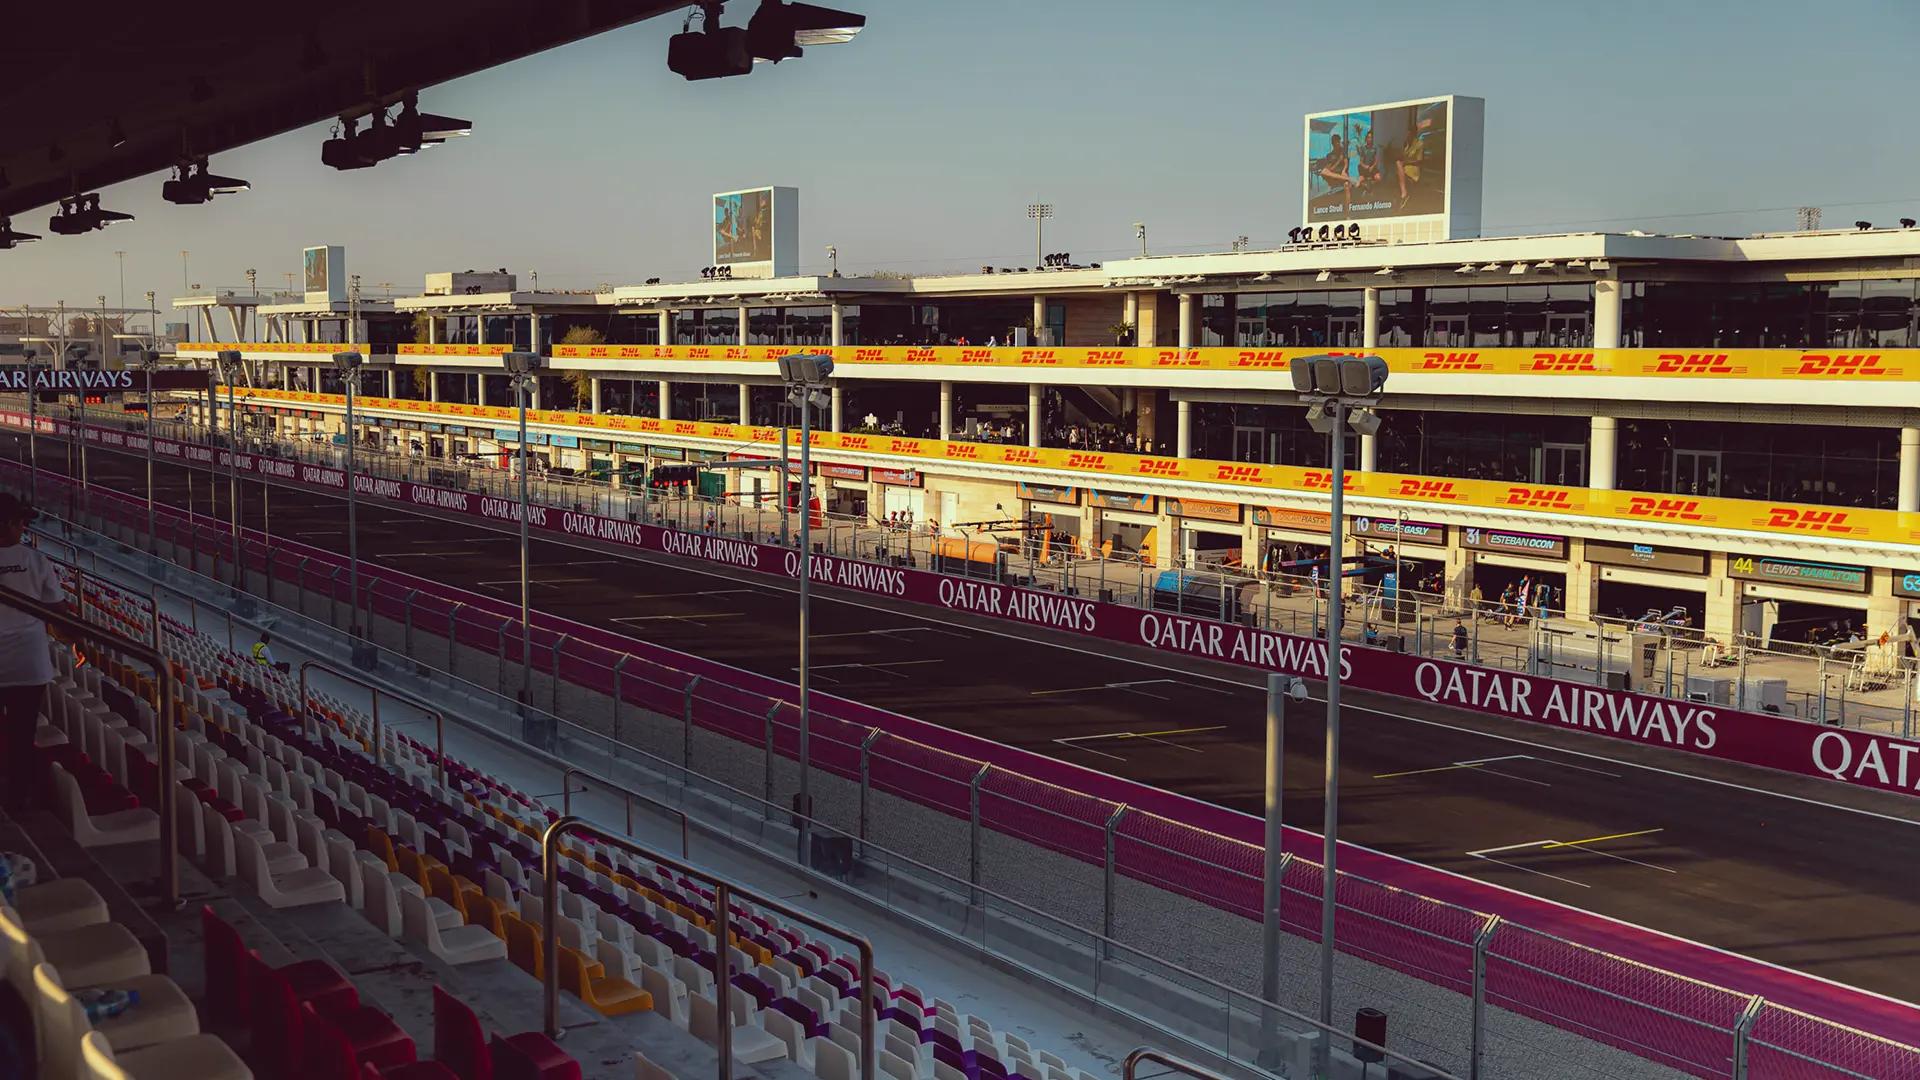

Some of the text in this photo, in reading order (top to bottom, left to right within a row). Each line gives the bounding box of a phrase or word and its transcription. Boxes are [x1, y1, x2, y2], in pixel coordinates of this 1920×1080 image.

[1313, 206, 1328, 214] Lance
[1348, 202, 1373, 211] Fernando
[1373, 201, 1392, 209] Alonso
[621, 348, 640, 357] DHL
[654, 348, 674, 357] DHL
[689, 349, 709, 358] DHL
[726, 349, 748, 359] DHL
[855, 349, 884, 361] DHL
[907, 350, 937, 362] DHL
[961, 350, 993, 363] DHL
[1021, 351, 1056, 364] DHL
[1087, 351, 1125, 364] DHL
[1158, 352, 1201, 365] DHL
[1237, 352, 1287, 367] DHL
[1422, 353, 1482, 370] DHL
[1531, 353, 1597, 371] DHL
[1656, 354, 1735, 373] DHL
[1798, 355, 1886, 375] DHL
[35, 370, 132, 388] AIRWAYS
[641, 421, 660, 430] DHL
[675, 423, 696, 434] DHL
[713, 426, 734, 437] DHL
[752, 429, 776, 441] DHL
[841, 436, 868, 449] DHL
[891, 440, 920, 453] DHL
[946, 444, 977, 458] DHL
[1004, 449, 1040, 463] DHL
[1068, 454, 1106, 469] DHL
[1139, 459, 1180, 476] DHL
[1217, 465, 1263, 483] DHL
[412, 485, 467, 511] QATAR AIRWAYS
[1400, 480, 1457, 499] DHL
[1507, 488, 1572, 510] DHL
[481, 497, 508, 519] QATAR
[1629, 497, 1702, 520] DHL
[563, 512, 642, 545] QATAR AIRWAYS
[1355, 517, 1368, 532] 10
[1404, 525, 1429, 536] GASLY
[1768, 508, 1852, 533] DHL
[1466, 528, 1555, 549] 31 ESTEBAN OCON
[662, 530, 758, 567] QATAR AIRWAYS
[837, 560, 905, 596] AIRWAYS
[1734, 557, 1860, 583] 44 LEWIS HAMILTON
[939, 578, 1096, 632] QATAR AIRWAYS
[1139, 613, 1224, 657] QATAR
[1415, 661, 1717, 749] QATAR AIRWAYS
[1811, 731, 1920, 790] QAT
